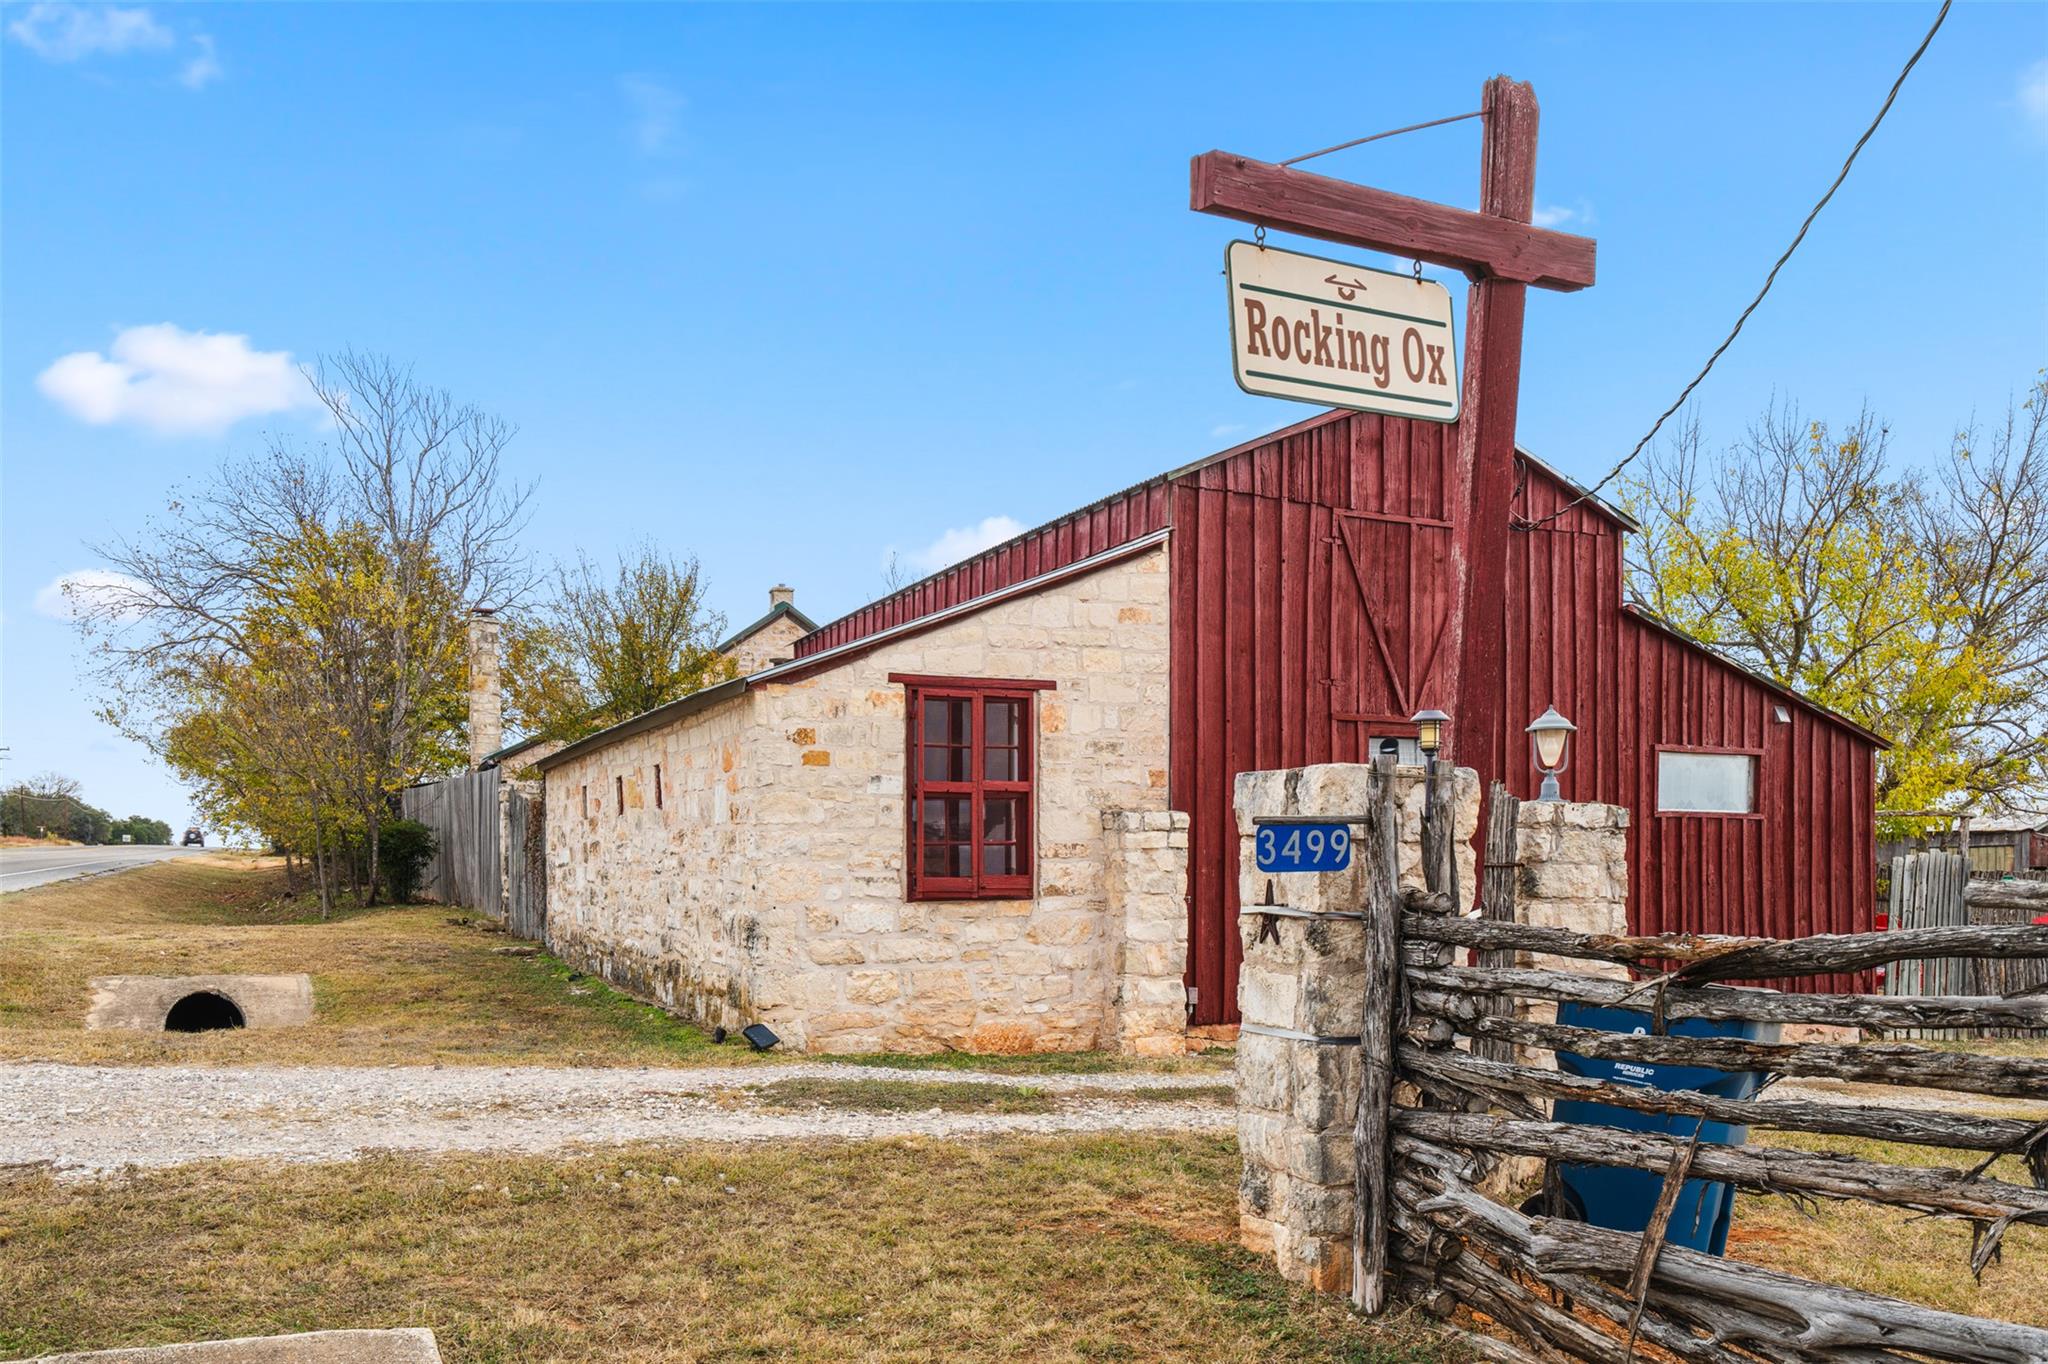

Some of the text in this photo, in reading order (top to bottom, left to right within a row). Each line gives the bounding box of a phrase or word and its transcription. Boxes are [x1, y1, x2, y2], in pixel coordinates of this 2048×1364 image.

[1244, 298, 1448, 389] Rocking Ox
[1258, 829, 1349, 865] 3499
[1614, 1062, 1655, 1076] REPUBLIC
